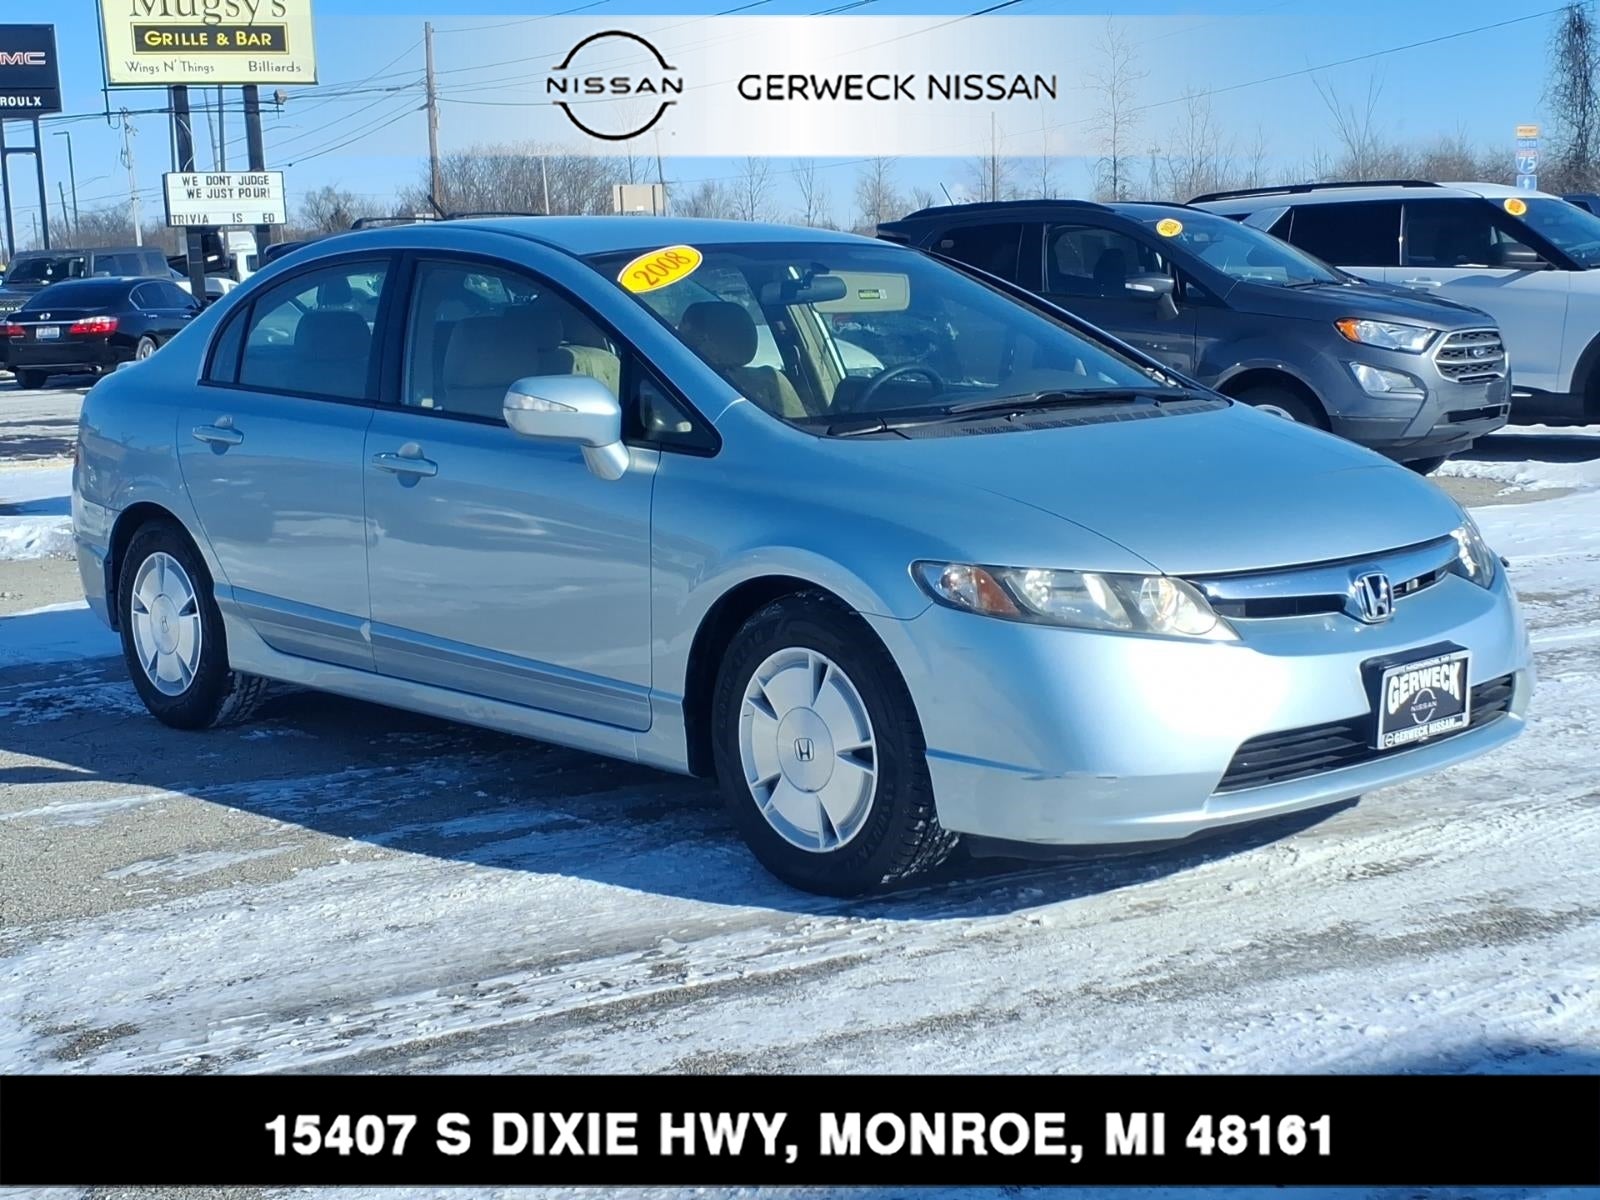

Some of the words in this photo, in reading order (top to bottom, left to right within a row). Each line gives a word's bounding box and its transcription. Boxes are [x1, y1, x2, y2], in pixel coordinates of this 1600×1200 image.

[129, 0, 286, 26] Mugsys
[216, 33, 229, 46] &
[125, 61, 159, 74] Wings
[181, 61, 215, 75] Things
[248, 60, 301, 73] Billiards
[1518, 156, 1536, 170] 75
[182, 176, 198, 186] WE
[206, 175, 231, 186] DONT
[238, 175, 270, 186] JUDGE
[187, 188, 202, 199] WE
[207, 188, 234, 199] JUST
[172, 214, 209, 225] TRIVIA
[232, 213, 243, 223] IS
[633, 251, 691, 286] 2008
[1388, 662, 1460, 714] GERWECK
[1411, 701, 1437, 711] NISSAN
[1394, 726, 1428, 743] GERWECK
